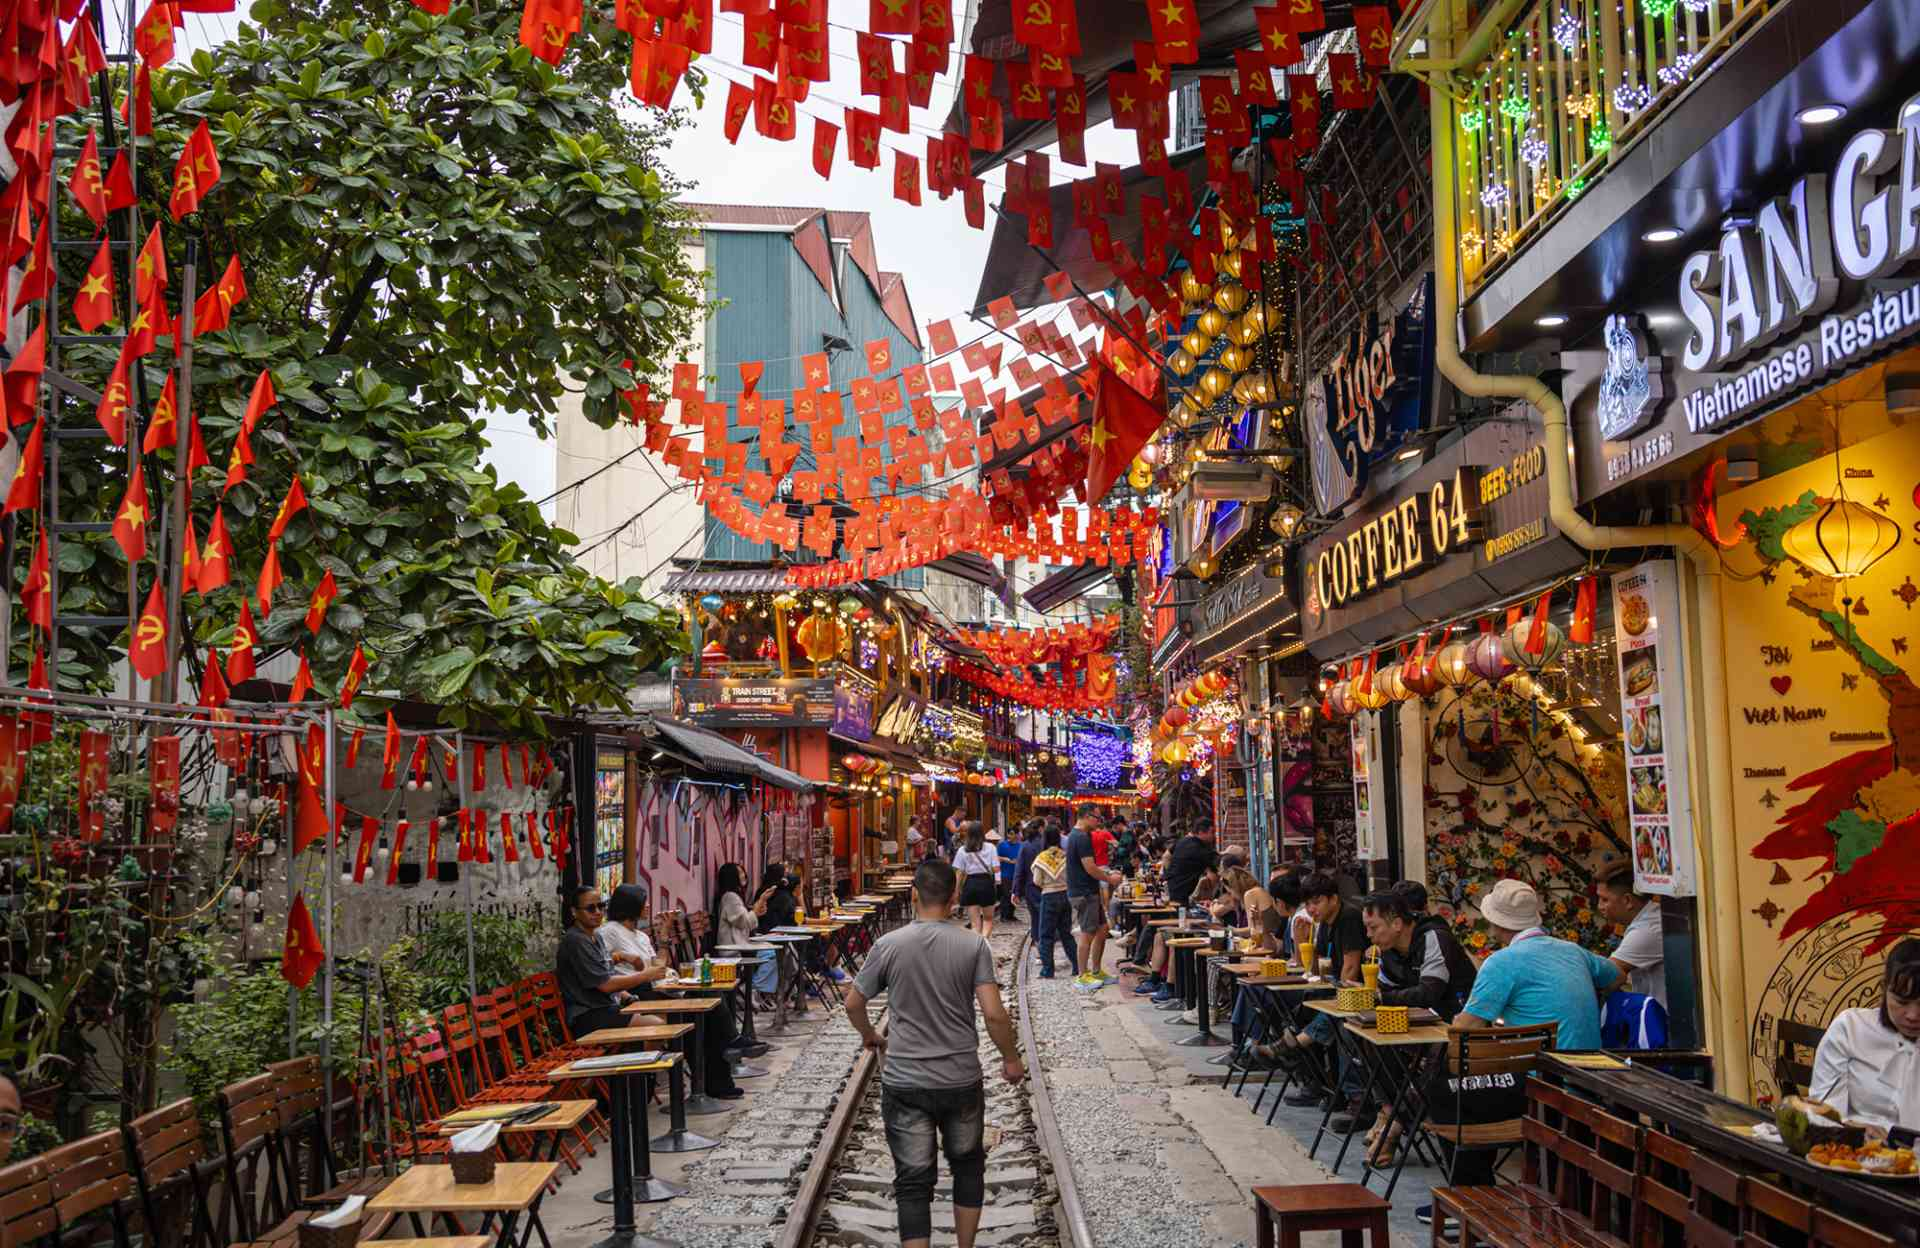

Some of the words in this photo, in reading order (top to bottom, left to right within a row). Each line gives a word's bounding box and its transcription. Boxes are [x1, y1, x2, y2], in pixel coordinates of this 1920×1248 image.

[1684, 340, 1814, 434] Vietnamese
[1820, 281, 1920, 370] Restau
[1329, 318, 1396, 453] Tiger
[1318, 495, 1423, 609] COFFEE
[1430, 469, 1469, 555] 64
[1760, 644, 1792, 666] Tôi
[1810, 639, 1836, 651] Laos
[732, 687, 751, 696] TRAIN
[752, 687, 777, 696] STREET
[1743, 705, 1781, 726] Việt
[1783, 704, 1827, 723] Nam
[1743, 766, 1786, 778] Thailand
